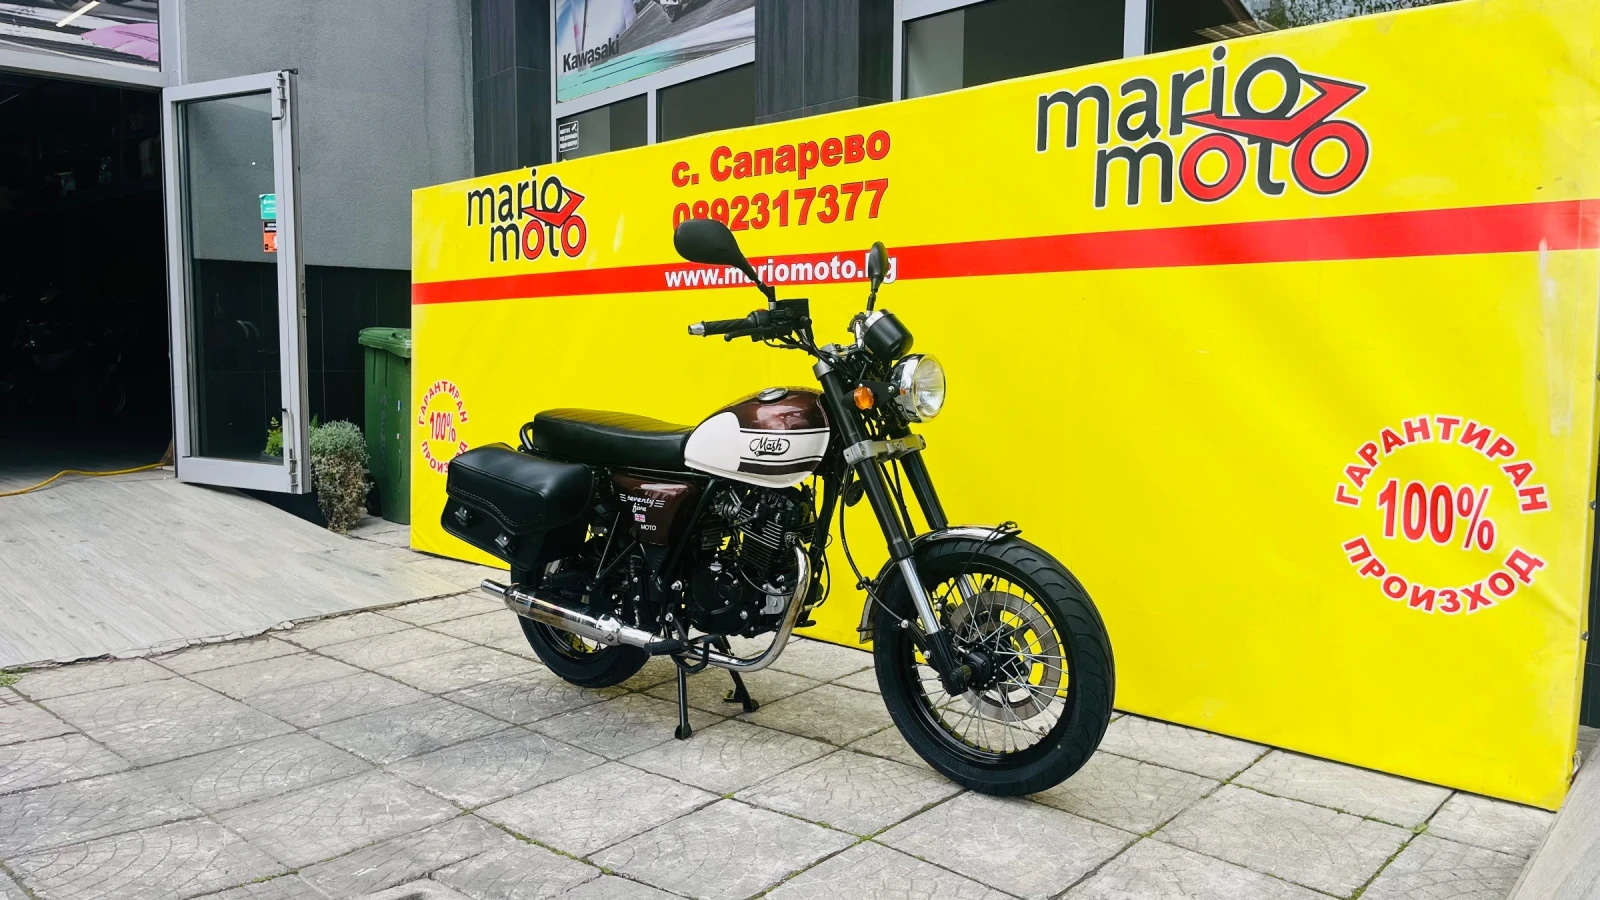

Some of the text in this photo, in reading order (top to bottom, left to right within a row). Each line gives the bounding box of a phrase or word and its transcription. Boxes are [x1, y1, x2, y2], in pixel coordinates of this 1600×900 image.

[563, 34, 620, 72] Kawasaki
[1037, 46, 1301, 151] mario
[672, 130, 890, 187] с. Сапарево
[1094, 119, 1370, 208] moto
[467, 168, 563, 227] mario
[490, 215, 587, 262] moto
[418, 380, 468, 425] ГАРАНТИРАН
[429, 411, 456, 442] 100%
[751, 437, 783, 452] Mash
[1335, 416, 1548, 512] ГАРАНТИРАН
[627, 495, 655, 507] seventy
[1378, 479, 1495, 551] 100%
[1343, 537, 1544, 613] ПРОИЗХОД
